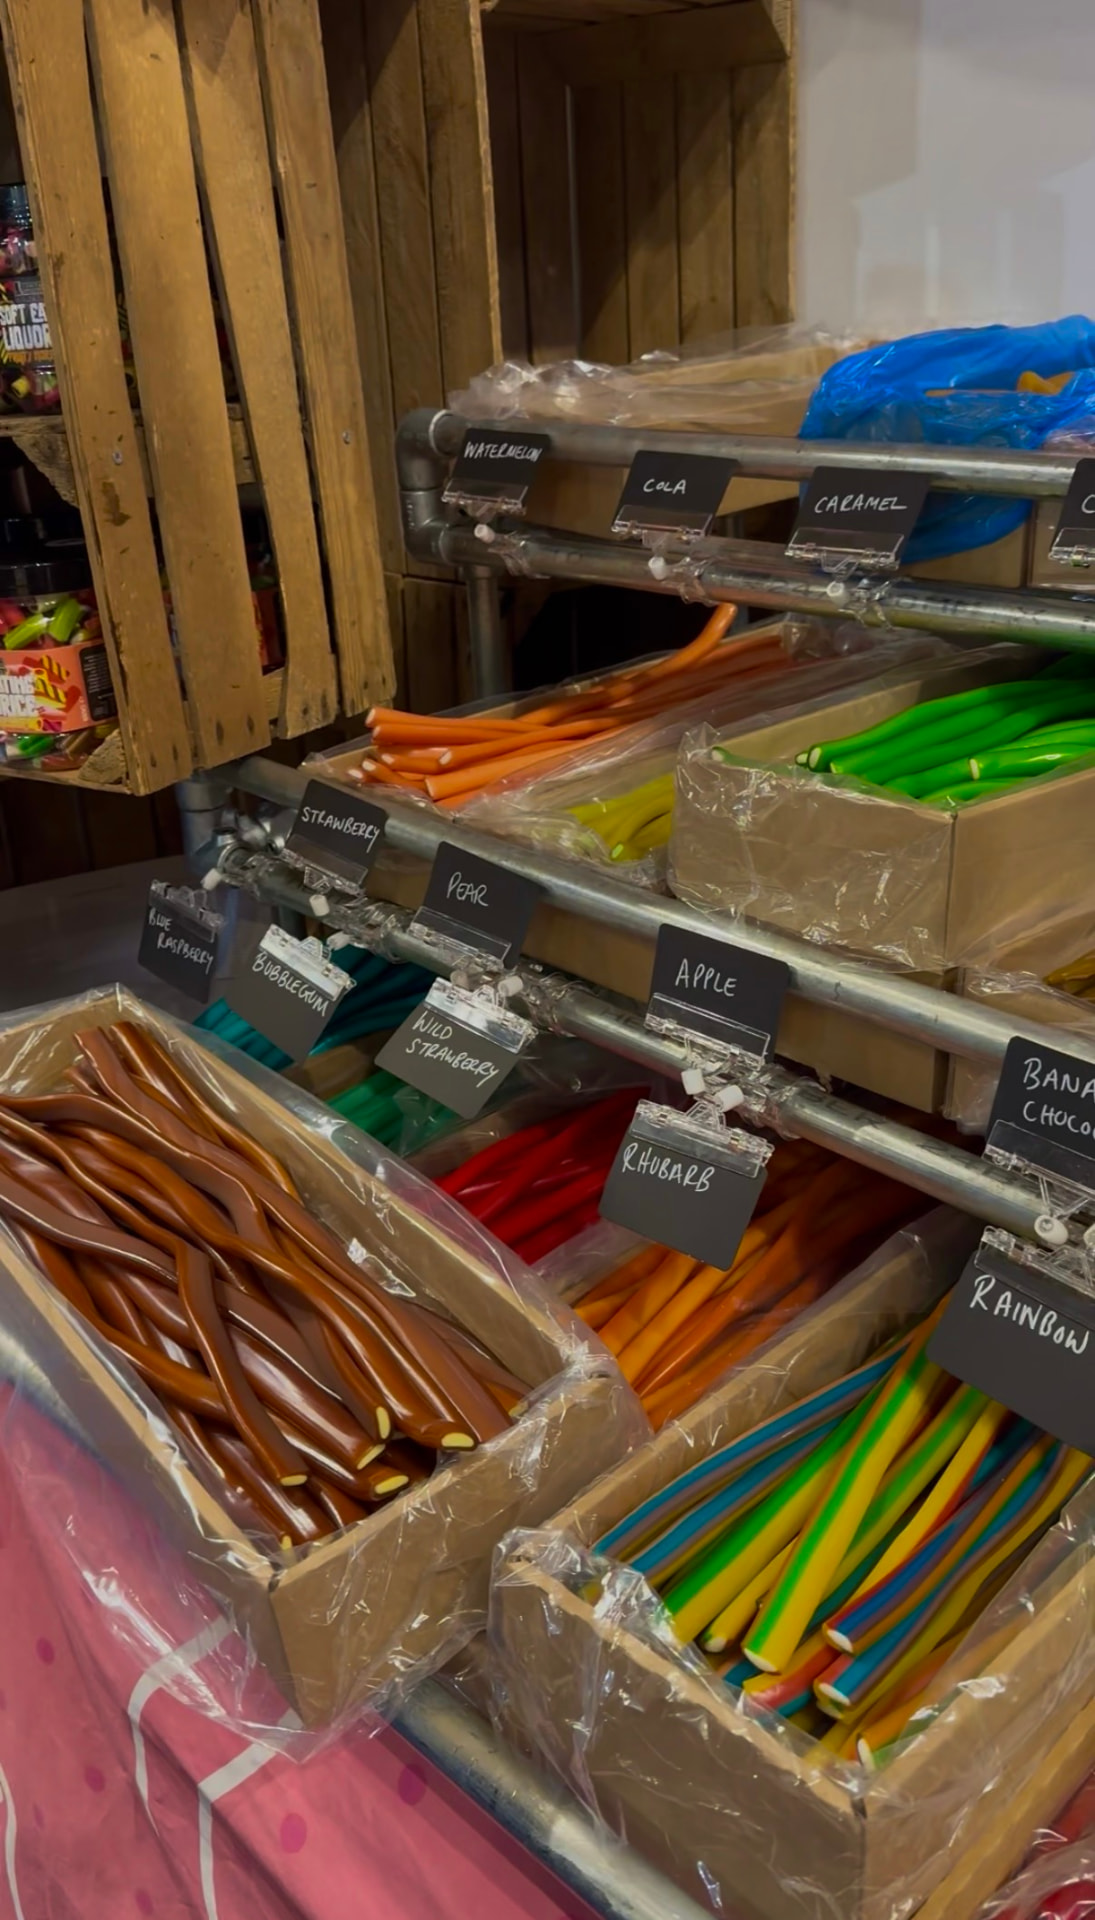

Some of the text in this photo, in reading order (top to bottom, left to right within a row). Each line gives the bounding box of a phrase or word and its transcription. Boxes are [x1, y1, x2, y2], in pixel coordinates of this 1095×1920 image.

[463, 441, 543, 462] WATERMELON
[642, 478, 687, 495] COLA
[814, 493, 908, 514] CARAMEL
[301, 806, 380, 854] STRAWBERRY
[446, 871, 489, 907] PEAR
[148, 907, 173, 932] BLUE
[157, 932, 214, 976] RASPBERRY
[251, 951, 330, 1017] BUBBLEGUM
[675, 958, 737, 997] APPLE
[412, 1010, 453, 1040] WILD
[405, 1038, 499, 1089] STRAWBERRY
[1023, 1057, 1095, 1103] BANA
[1023, 1101, 1095, 1140] CHOCO
[622, 1142, 716, 1193] RHUBARB
[969, 1274, 1090, 1355] RAINBOW
